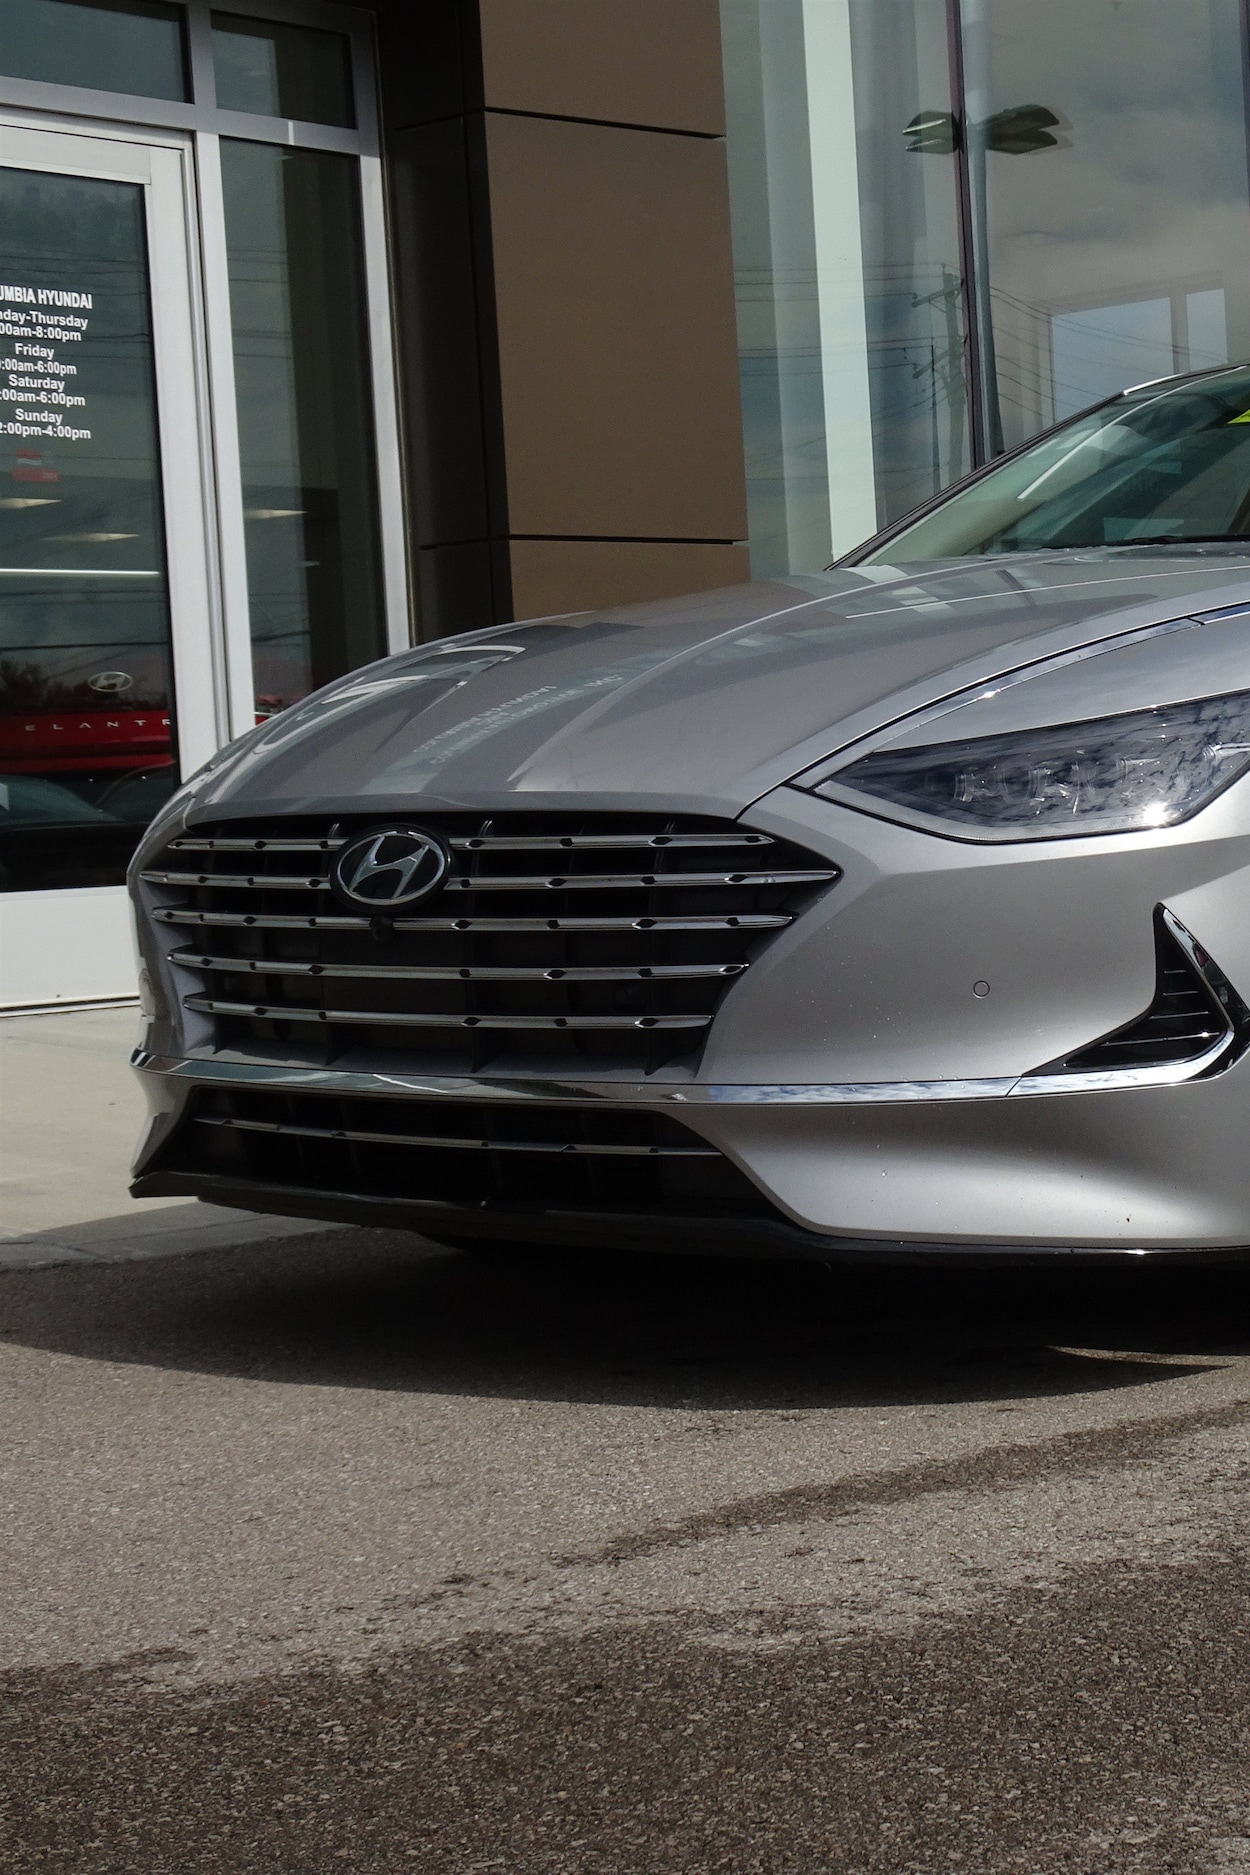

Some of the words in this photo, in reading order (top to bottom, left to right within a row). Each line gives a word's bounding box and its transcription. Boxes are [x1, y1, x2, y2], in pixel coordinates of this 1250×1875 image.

[38, 289, 93, 310] HYUNDAI
[15, 342, 55, 360] Friday
[0, 358, 77, 376] :00am-6:00pm
[8, 373, 65, 393] Saturday
[15, 408, 63, 425] Sunday
